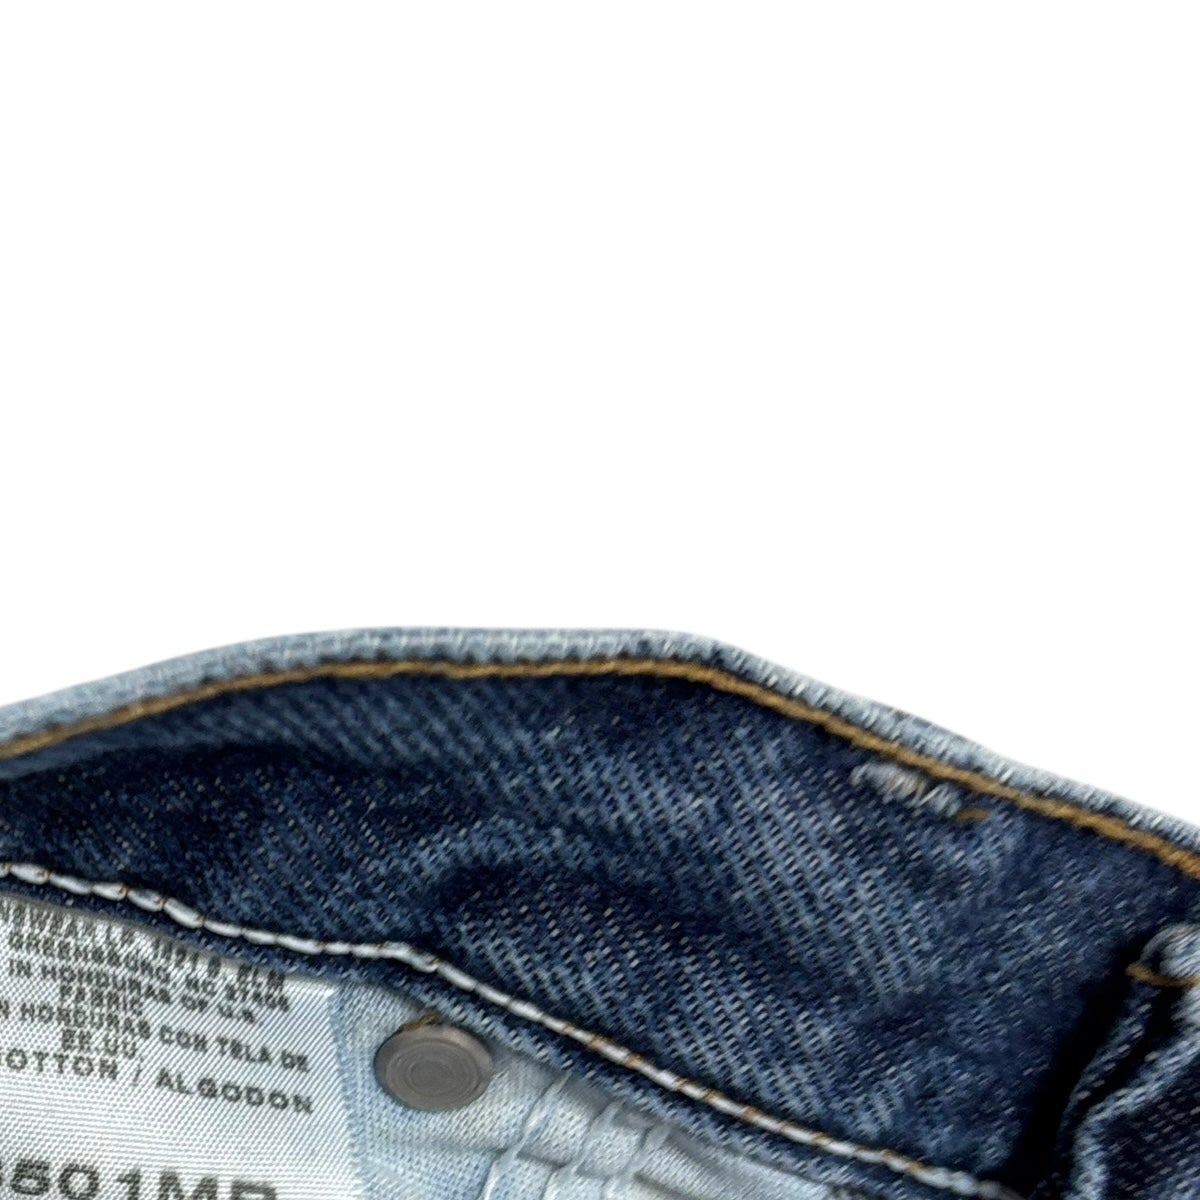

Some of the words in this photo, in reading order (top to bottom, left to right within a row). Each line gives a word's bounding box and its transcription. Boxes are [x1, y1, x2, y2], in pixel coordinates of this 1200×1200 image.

[8, 958, 32, 979] IN
[41, 963, 171, 1003] HONDURAS
[20, 1001, 151, 1040] HONDURAS
[159, 1023, 208, 1051] CON
[216, 1035, 273, 1066] TELA
[281, 1048, 310, 1074] DE
[156, 1066, 314, 1115] ALGODON
